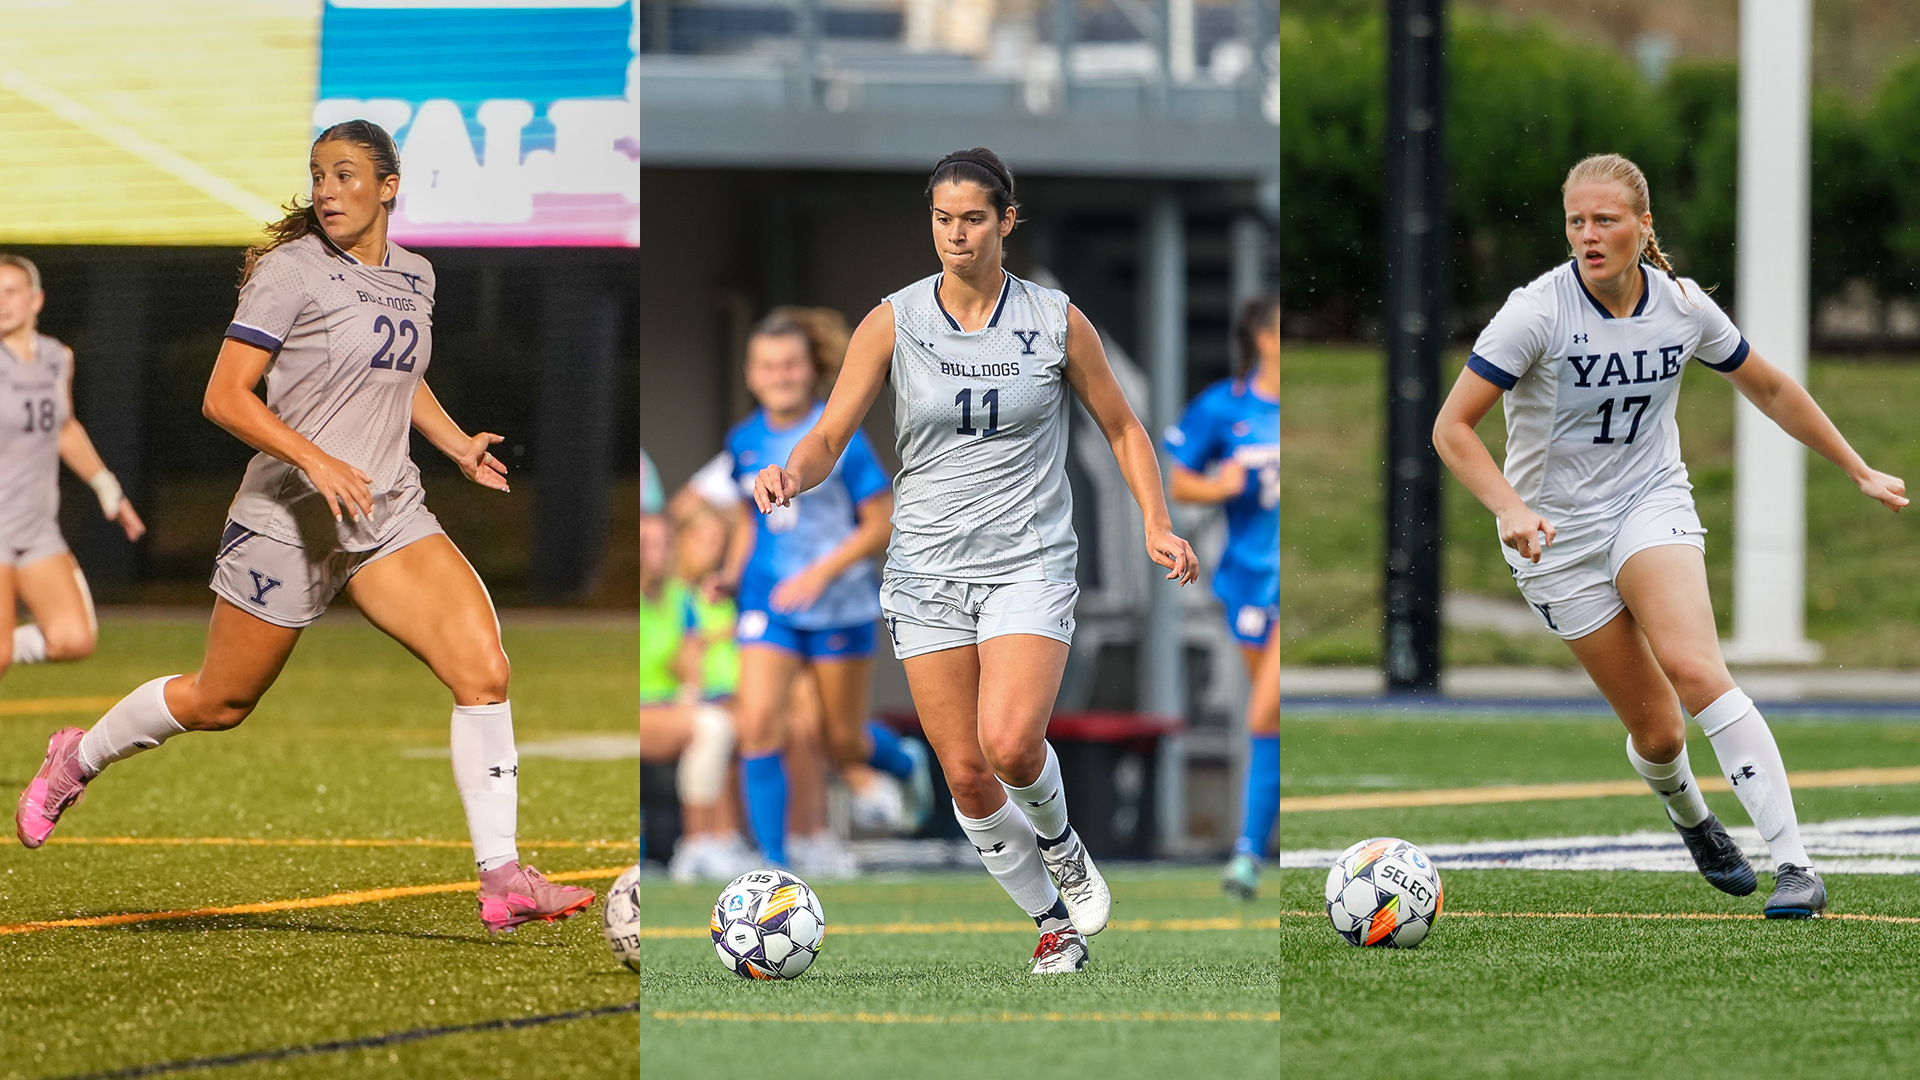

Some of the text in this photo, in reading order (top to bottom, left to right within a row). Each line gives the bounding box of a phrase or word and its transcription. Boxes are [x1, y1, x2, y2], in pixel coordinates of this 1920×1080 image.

[370, 315, 418, 372] 22
[1012, 330, 1040, 355] Y
[941, 362, 1020, 377] BULLDOGS
[1567, 345, 1683, 388] YALE
[24, 399, 55, 433] 18
[955, 388, 999, 438] 11
[1593, 395, 1651, 444] 17
[248, 569, 282, 607] Y
[1381, 865, 1433, 908] SELECT
